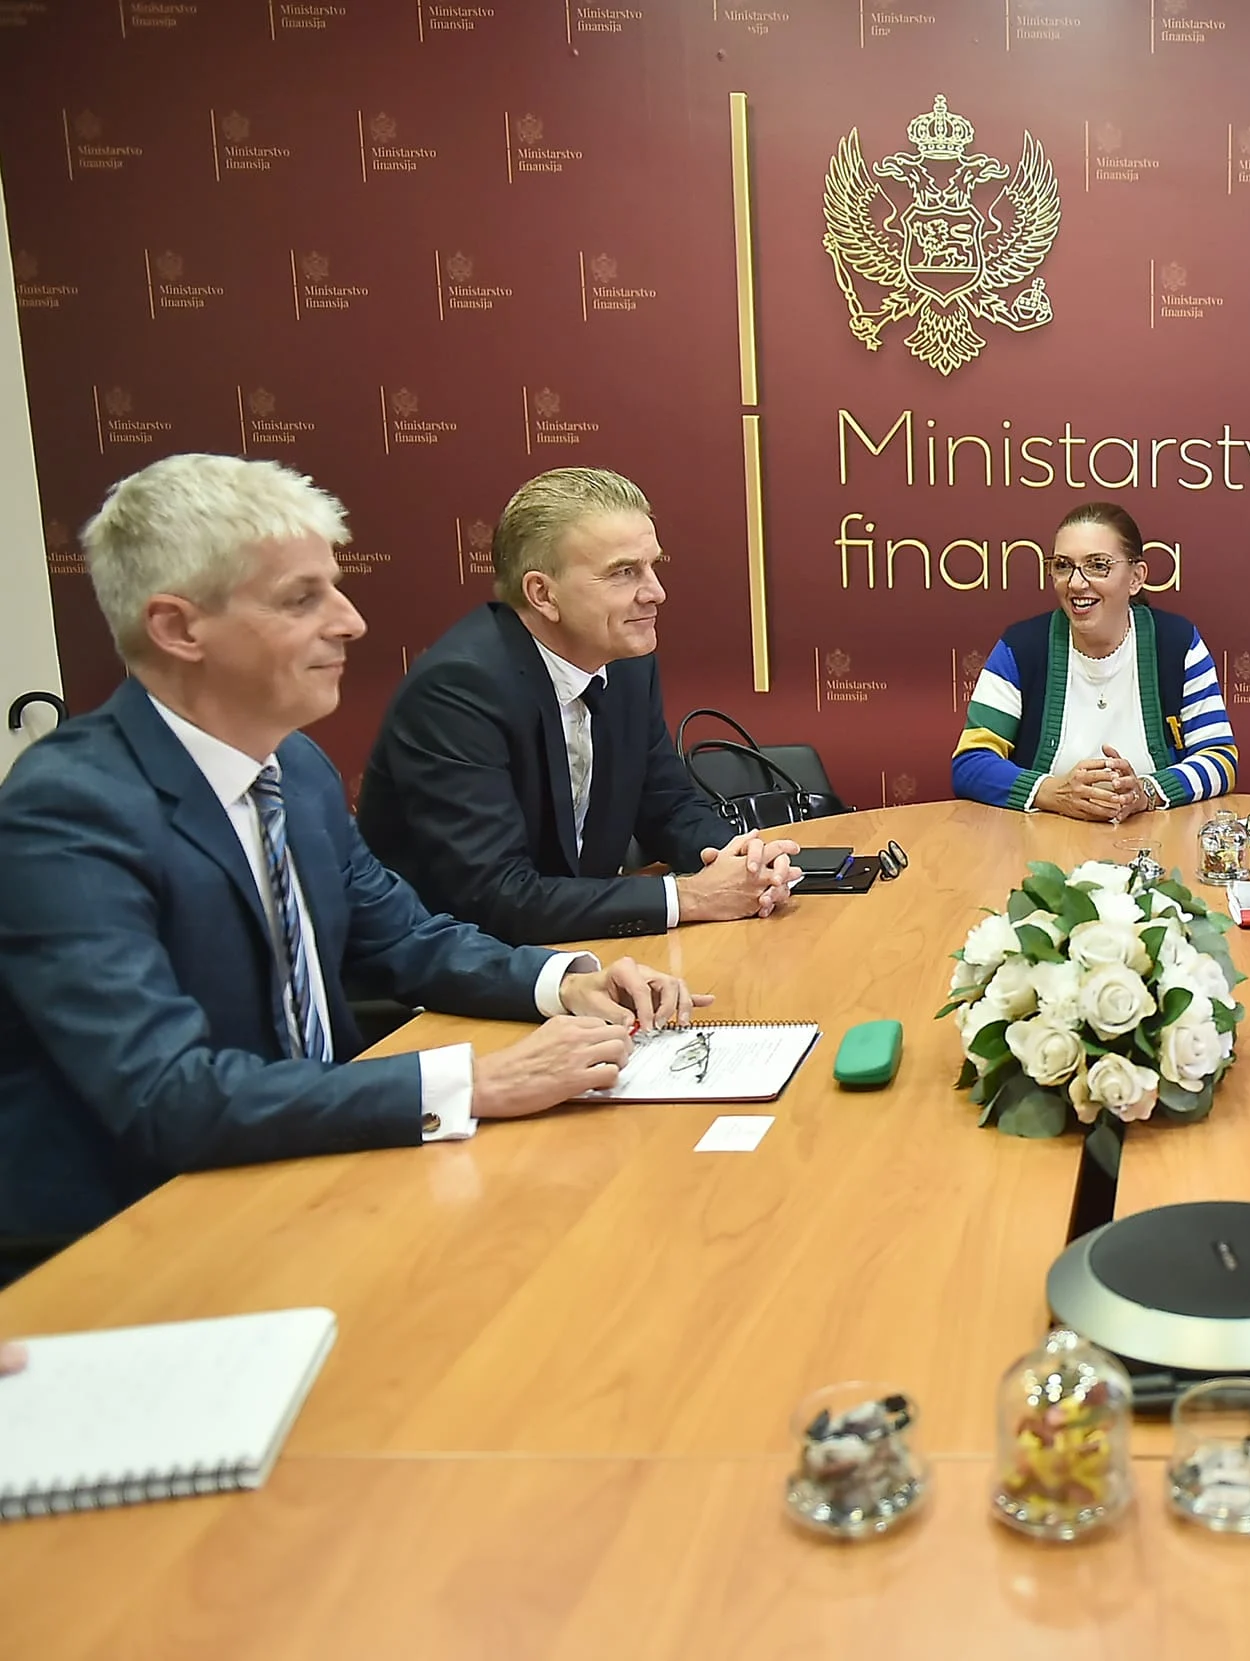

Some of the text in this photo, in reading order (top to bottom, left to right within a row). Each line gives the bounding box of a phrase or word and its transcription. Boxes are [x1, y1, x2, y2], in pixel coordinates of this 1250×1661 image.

[280, 5, 346, 16] Ministarstvo
[429, 6, 495, 17] Ministarstvo
[577, 8, 642, 19] Ministarstvo
[724, 10, 789, 21] Ministarstvo
[281, 17, 326, 29] finansija
[430, 18, 474, 30] finansija
[871, 13, 936, 24] Ministarstvo
[1016, 16, 1081, 27] Ministarstvo
[577, 20, 622, 32] finansija
[1162, 19, 1226, 30] Ministarstvo
[1016, 28, 1060, 40] finansija
[1161, 31, 1205, 43] finansija
[225, 147, 290, 158] Ministarstvo
[371, 147, 437, 158] Ministarstvo
[518, 149, 583, 160] Ministarstvo
[225, 159, 270, 171] finansija
[372, 159, 417, 171] finansija
[518, 161, 562, 173] finansija
[1096, 157, 1160, 168] Ministarstvo
[1096, 169, 1139, 181] finansija
[159, 284, 224, 295] Ministarstvo
[304, 285, 369, 296] Ministarstvo
[449, 285, 513, 296] Ministarstvo
[593, 287, 657, 298] Ministarstvo
[19, 297, 60, 309] inansija
[160, 296, 205, 308] finansija
[305, 297, 349, 309] finansija
[449, 297, 493, 309] finansija
[593, 299, 637, 311] finansija
[1161, 295, 1224, 306] Ministarstvo
[1161, 307, 1204, 319] finansija
[108, 420, 172, 431] Ministarstvo
[251, 420, 315, 431] Ministarstvo
[394, 420, 457, 431] Ministarstvo
[536, 421, 599, 432] Ministarstvo
[109, 432, 153, 443] finansija
[252, 432, 296, 443] finansija
[394, 432, 438, 443] finansija
[536, 433, 580, 444] finansija
[834, 512, 1183, 592] finana
[470, 563, 496, 573] finan
[826, 679, 887, 690] Ministarstvo
[826, 691, 868, 702] finansija
